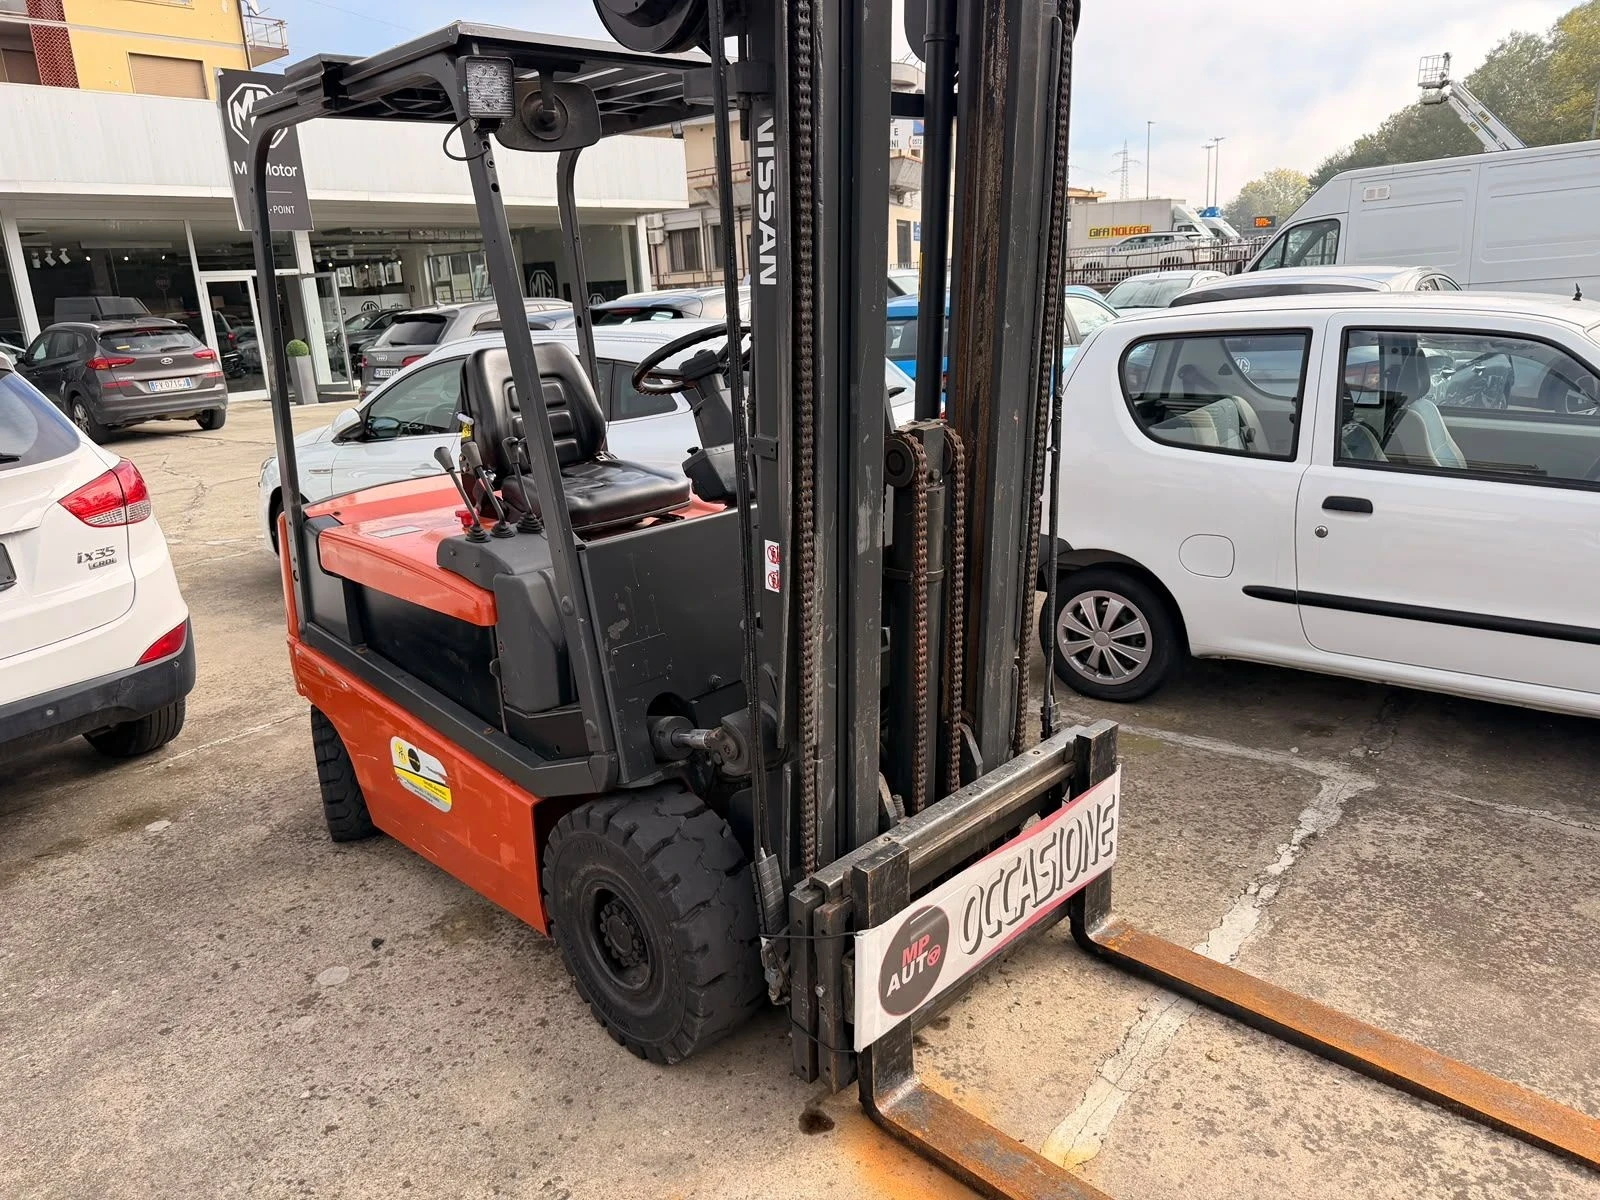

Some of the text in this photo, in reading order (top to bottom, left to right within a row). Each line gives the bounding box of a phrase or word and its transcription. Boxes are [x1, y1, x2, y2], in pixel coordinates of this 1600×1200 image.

[272, 205, 295, 214] POINT
[757, 112, 777, 285] NISSAN
[531, 273, 553, 298] MG
[958, 795, 1116, 955] OCCASIONE
[902, 934, 931, 969] MP
